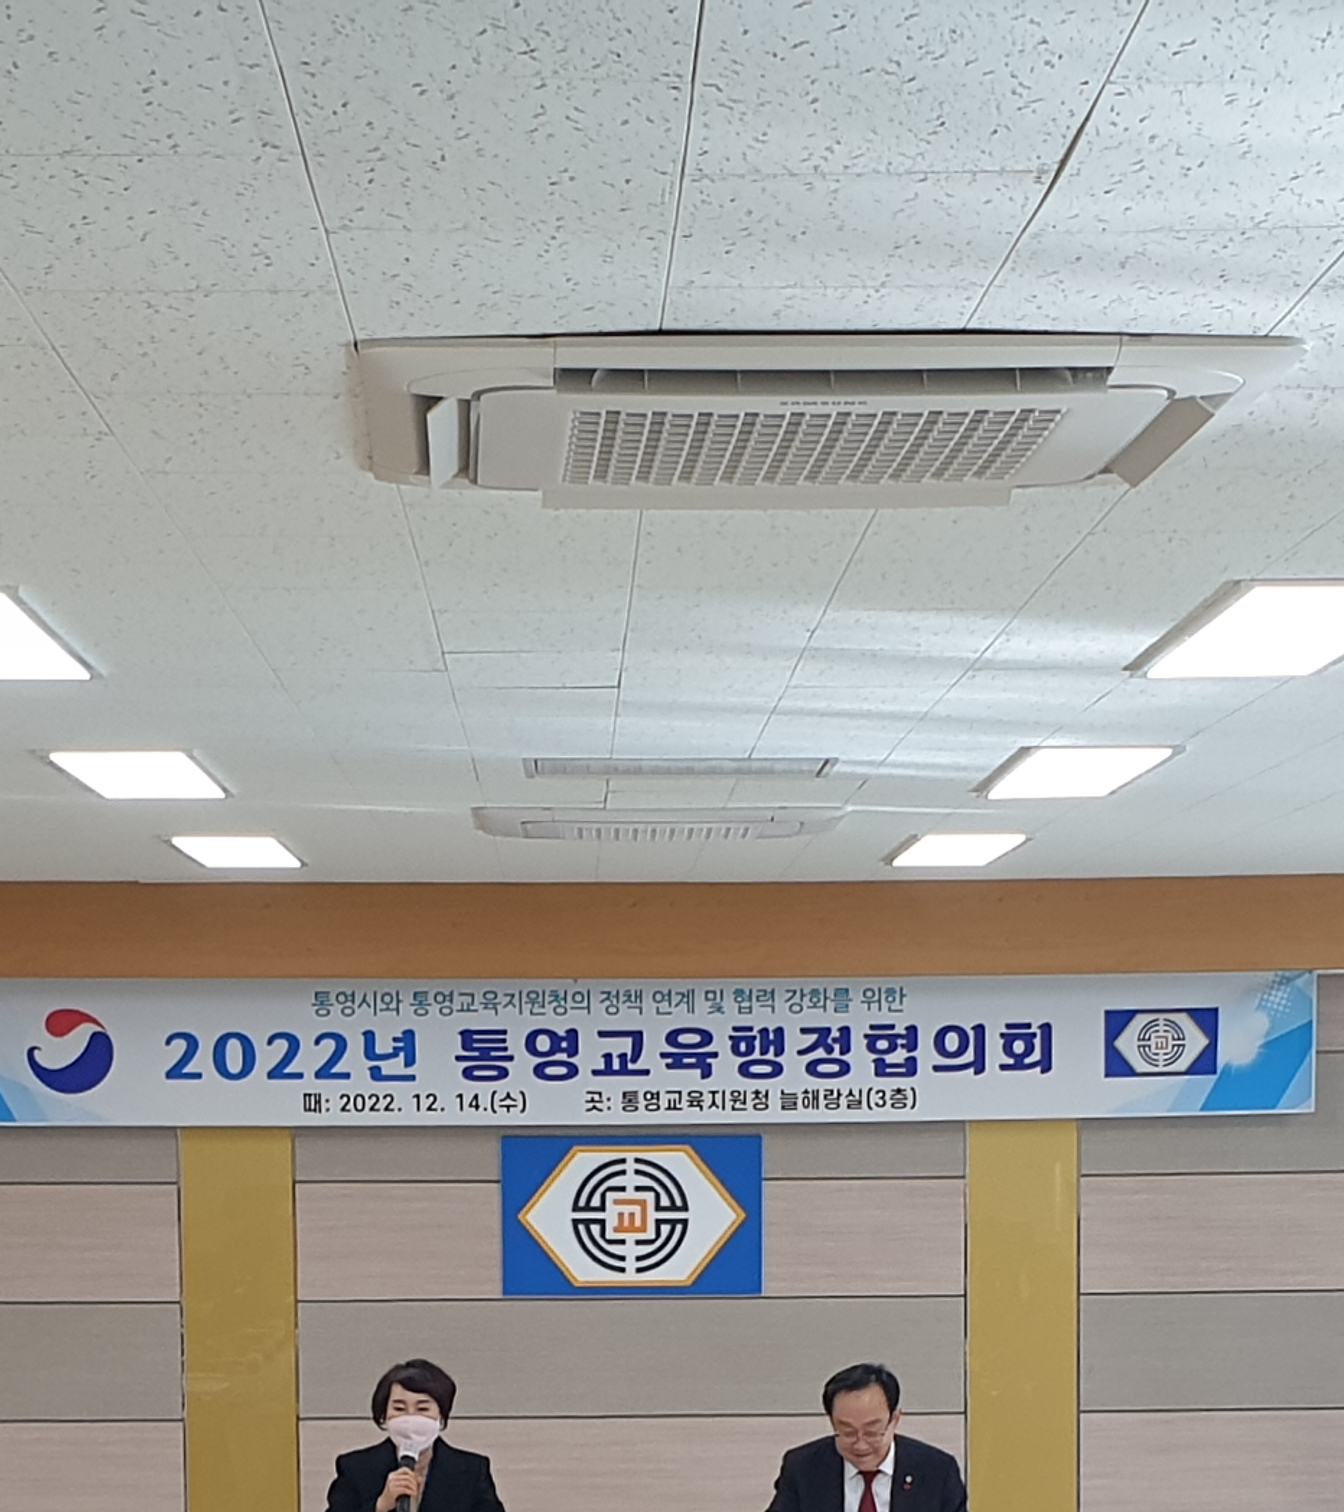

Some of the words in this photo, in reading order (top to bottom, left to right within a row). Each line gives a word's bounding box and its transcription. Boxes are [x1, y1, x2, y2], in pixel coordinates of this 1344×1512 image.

[311, 990, 403, 1017] 통영시와
[409, 989, 591, 1017] 통영교육지원청의
[599, 988, 643, 1016] 정책
[652, 988, 695, 1015] 연계
[704, 988, 726, 1015] 및
[732, 987, 776, 1014] 협력
[784, 987, 853, 1014] 강화를
[860, 986, 907, 1013] 위한
[163, 1028, 416, 1083] 2022년
[454, 1022, 1054, 1083] 통영교육행정협의회
[303, 1092, 330, 1114] 때:
[339, 1094, 402, 1113] 2022.
[413, 1094, 445, 1113] 12.
[456, 1091, 527, 1115] 14.(수)
[584, 1090, 611, 1113] 곳:
[620, 1089, 770, 1112] 통영교육지원청
[779, 1086, 918, 1112] 늘해랑실(3층)
